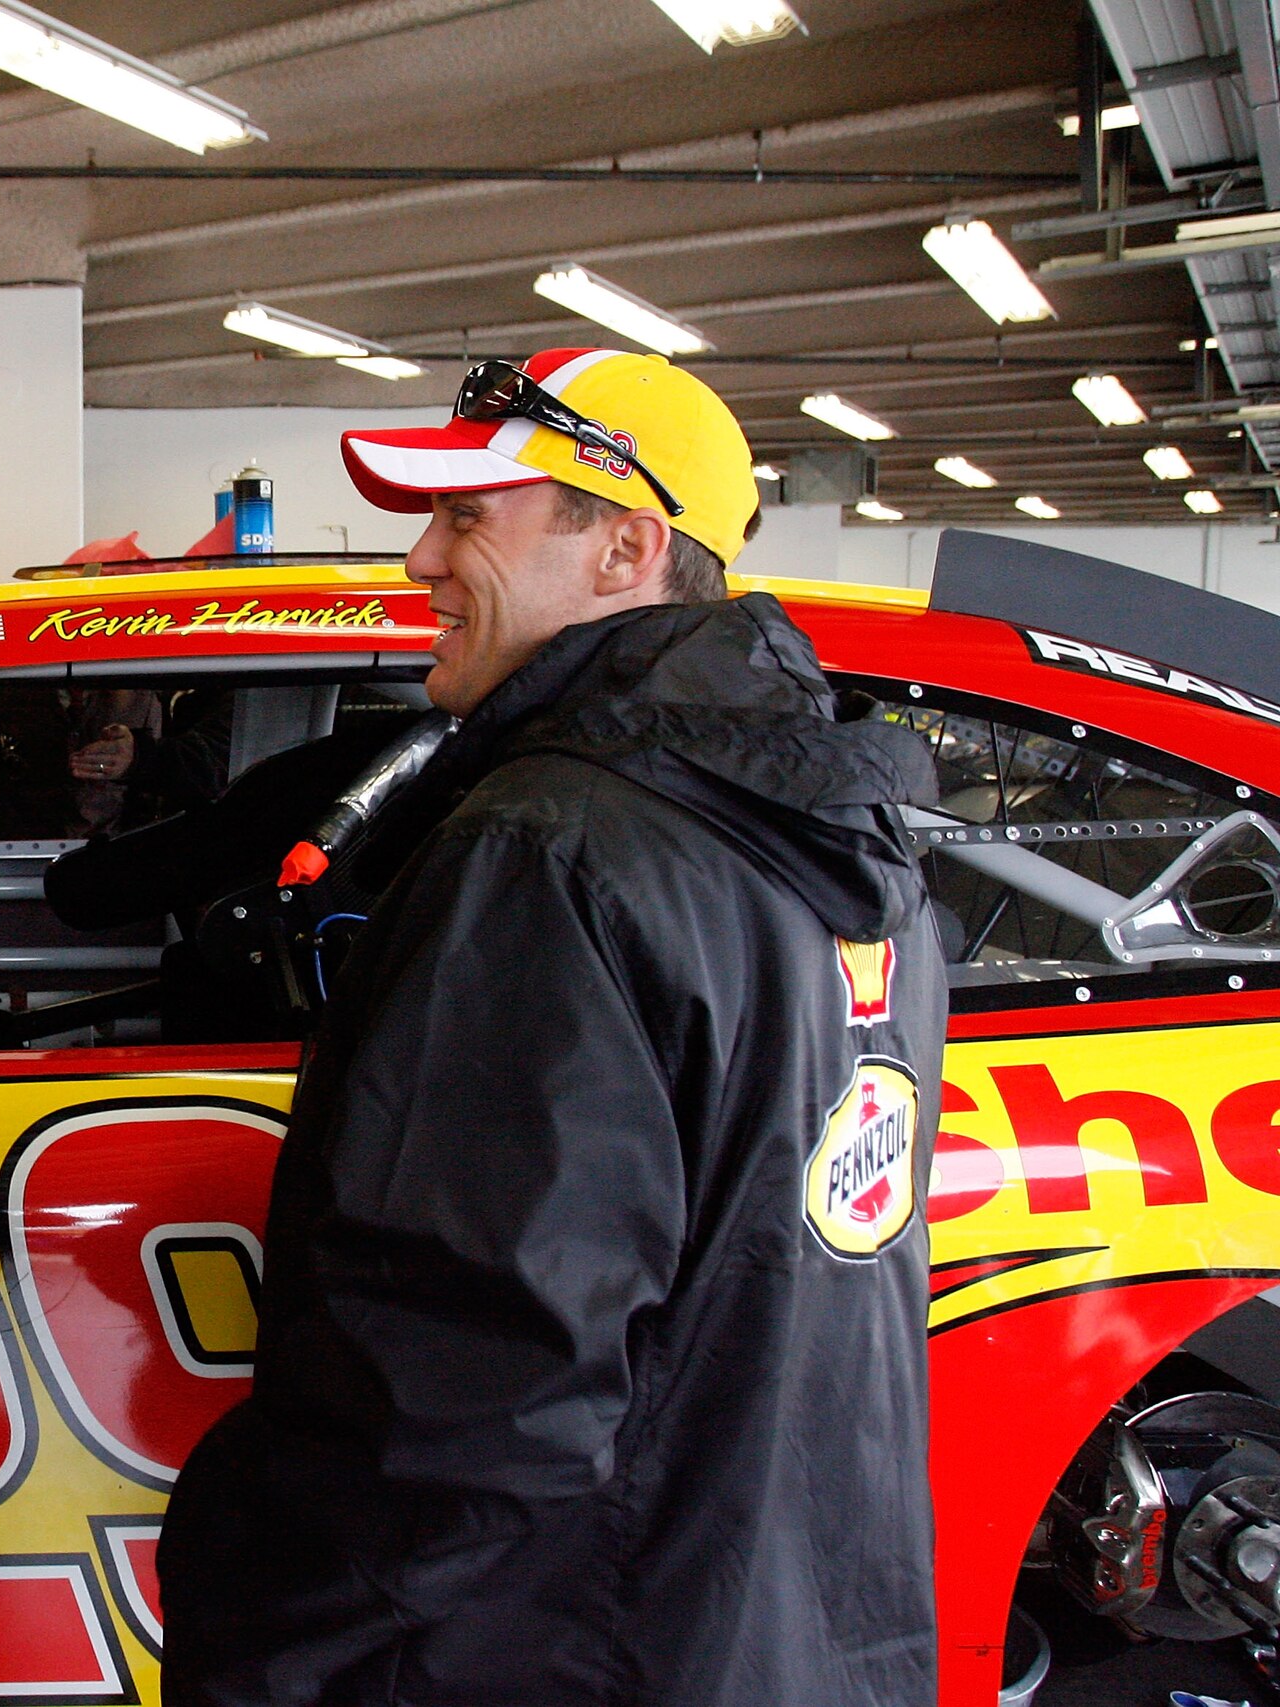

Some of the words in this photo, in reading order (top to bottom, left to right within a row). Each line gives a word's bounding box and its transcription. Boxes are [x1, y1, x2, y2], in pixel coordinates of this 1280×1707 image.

[574, 419, 637, 480] 29
[28, 603, 176, 641] Kevin
[181, 597, 389, 635] Harvick
[826, 1102, 909, 1216] PENNZOIL
[1138, 1510, 1167, 1589] brembo
